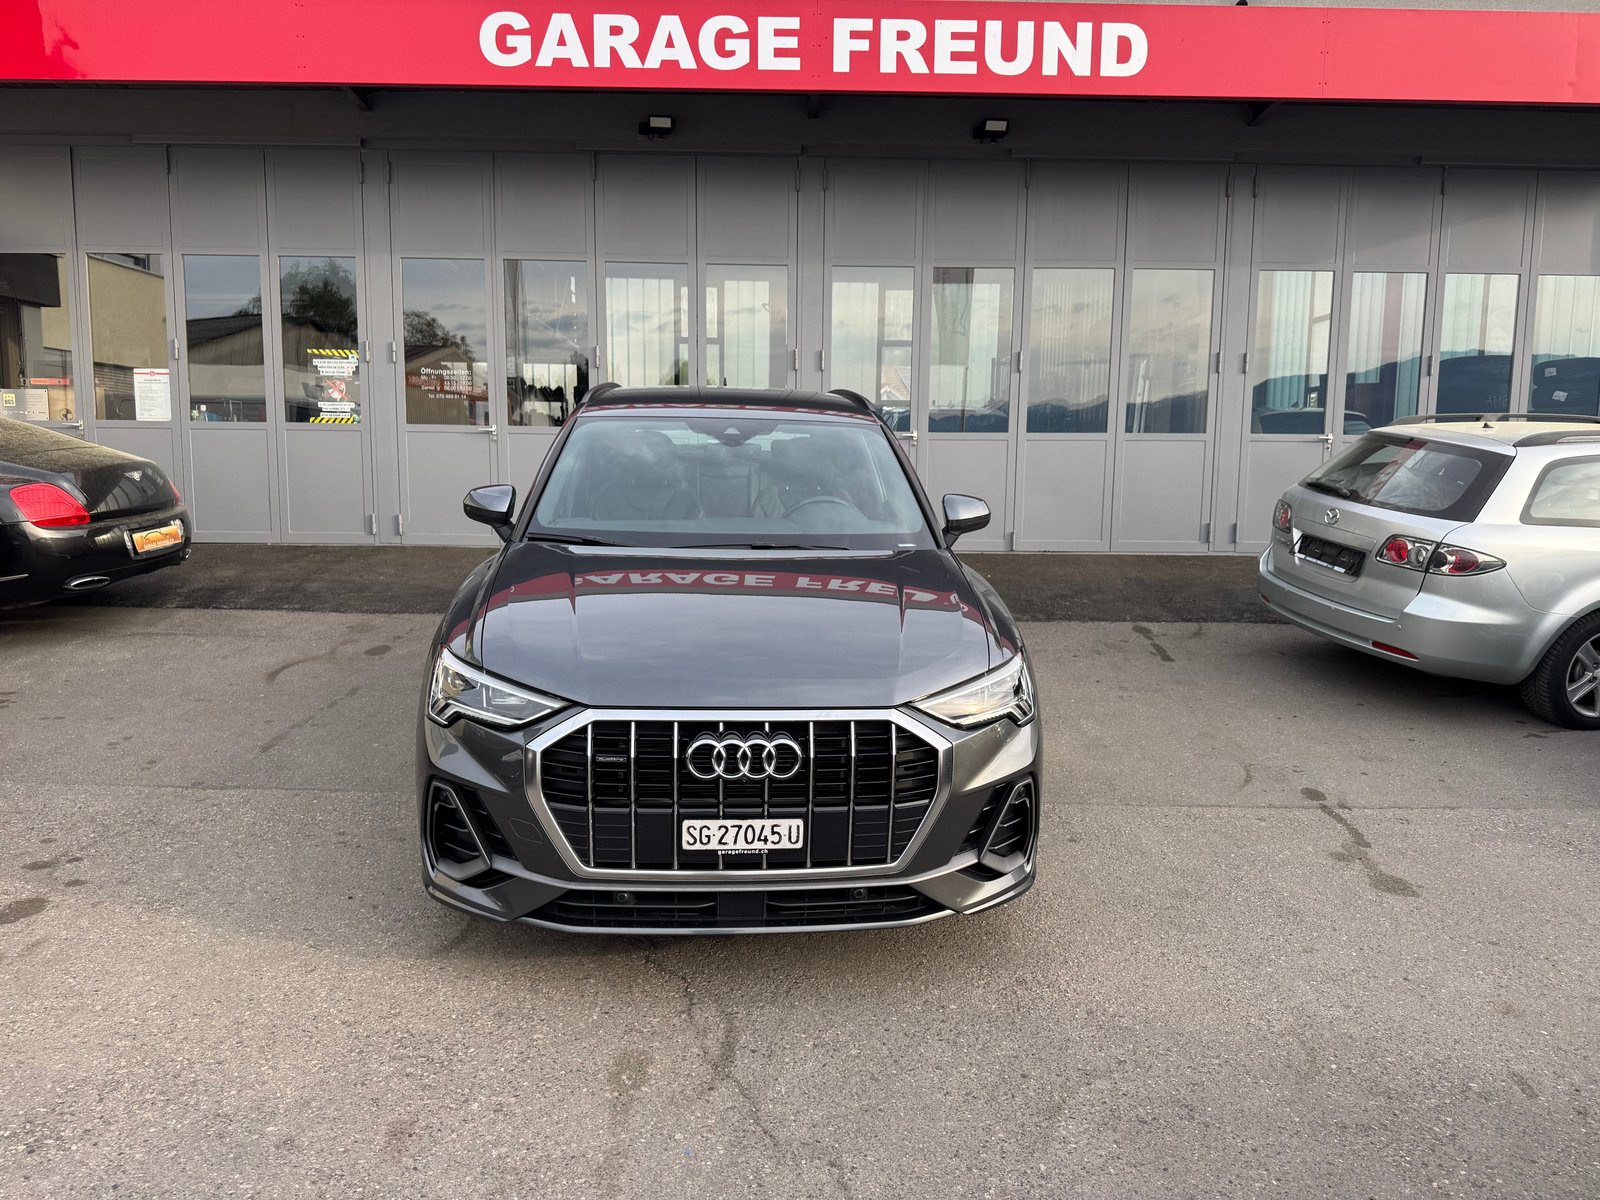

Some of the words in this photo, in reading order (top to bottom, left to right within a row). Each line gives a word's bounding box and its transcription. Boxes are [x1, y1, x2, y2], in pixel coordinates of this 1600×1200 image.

[478, 12, 800, 71] GARAGE
[832, 18, 1149, 78] FREUND
[420, 367, 472, 375] Öffnungszeiten:
